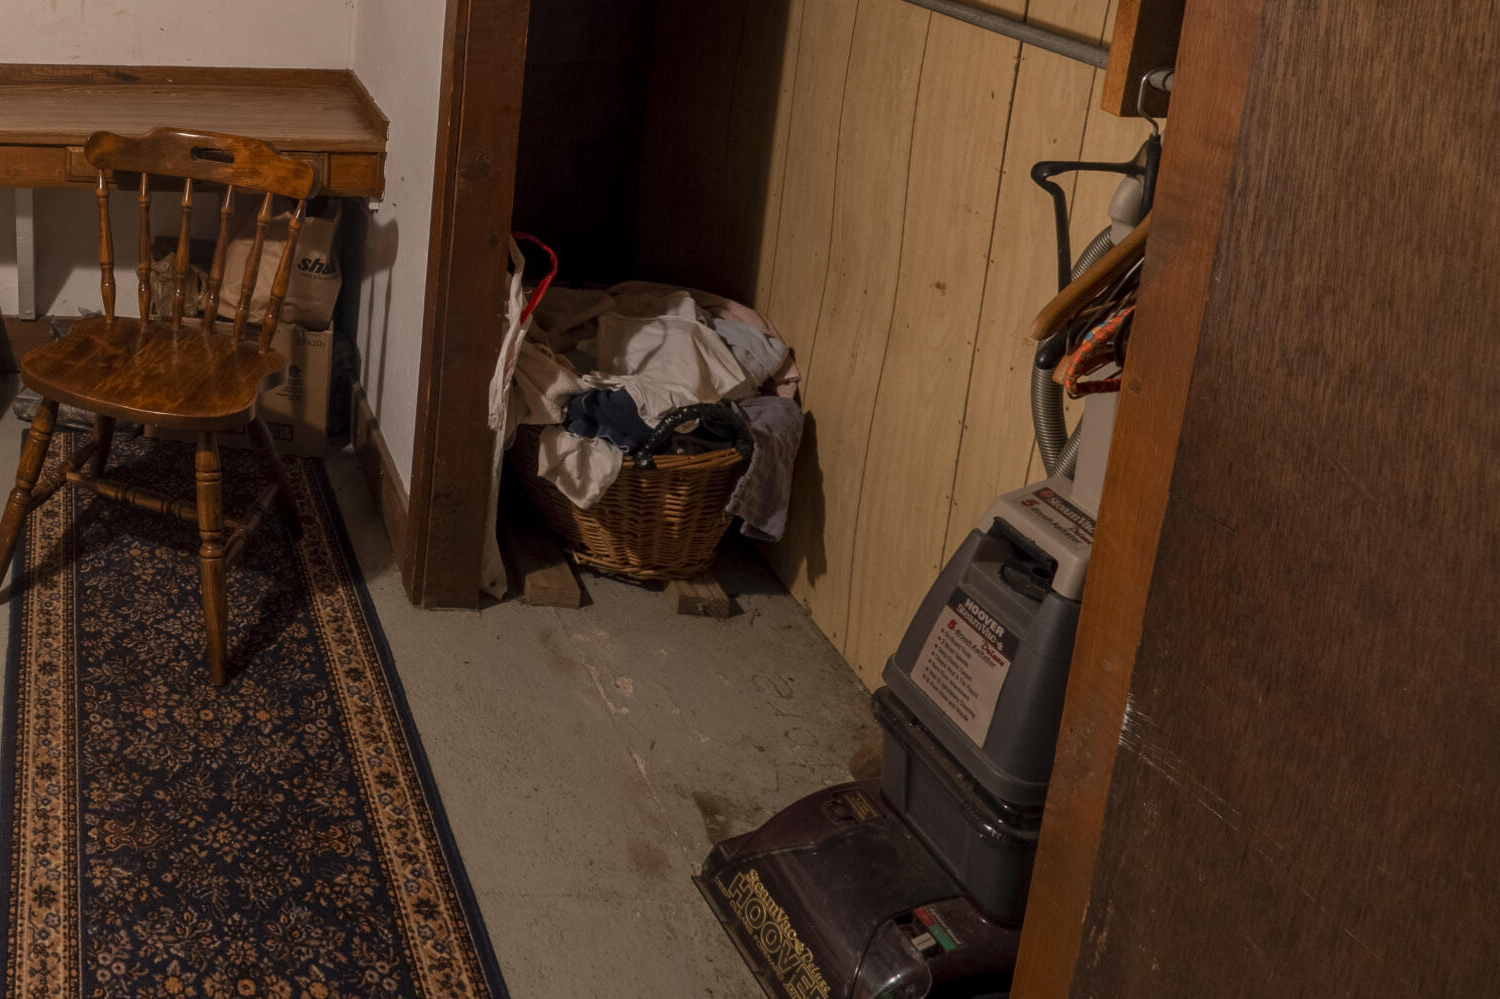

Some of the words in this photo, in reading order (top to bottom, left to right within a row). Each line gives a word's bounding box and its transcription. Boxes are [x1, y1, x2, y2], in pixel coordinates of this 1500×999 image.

[956, 603, 997, 644] SteamVac
[965, 598, 1005, 638] HOOVER
[747, 868, 797, 941] SteamVac
